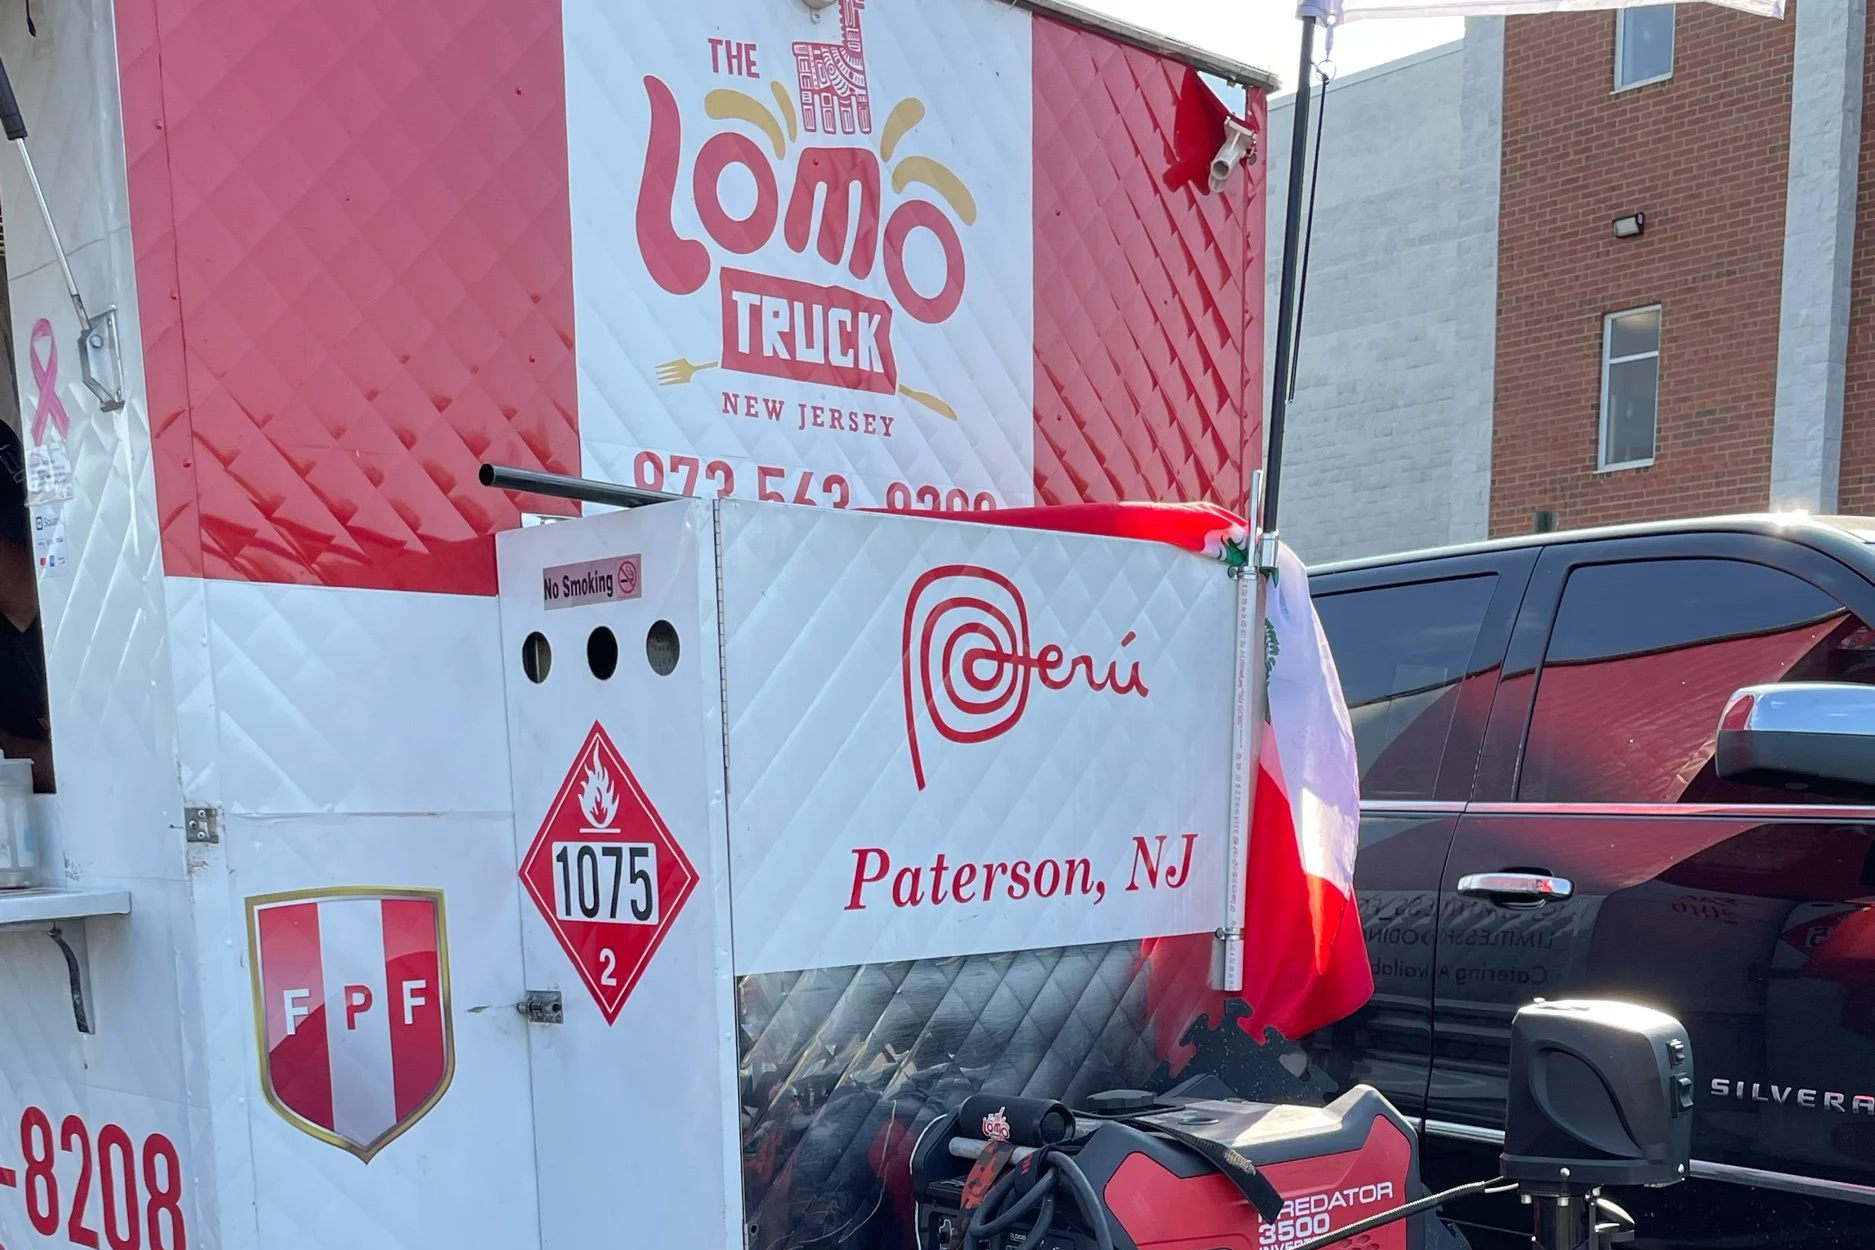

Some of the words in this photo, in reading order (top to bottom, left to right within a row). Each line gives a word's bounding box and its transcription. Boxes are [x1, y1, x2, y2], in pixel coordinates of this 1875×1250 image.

[708, 37, 760, 79] THE
[731, 289, 885, 375] TRUCK
[721, 391, 786, 422] NEW
[798, 403, 896, 438] JERSEY
[543, 577, 559, 601] No
[562, 570, 614, 598] Smoking
[556, 844, 654, 922] 1075
[843, 846, 1107, 912] Paterson,
[1125, 833, 1199, 892] NJ
[599, 946, 617, 987] 2
[1710, 1077, 1875, 1116] SILVERA
[1258, 1181, 1393, 1223] REDATOR
[1258, 1212, 1331, 1245] 3500
